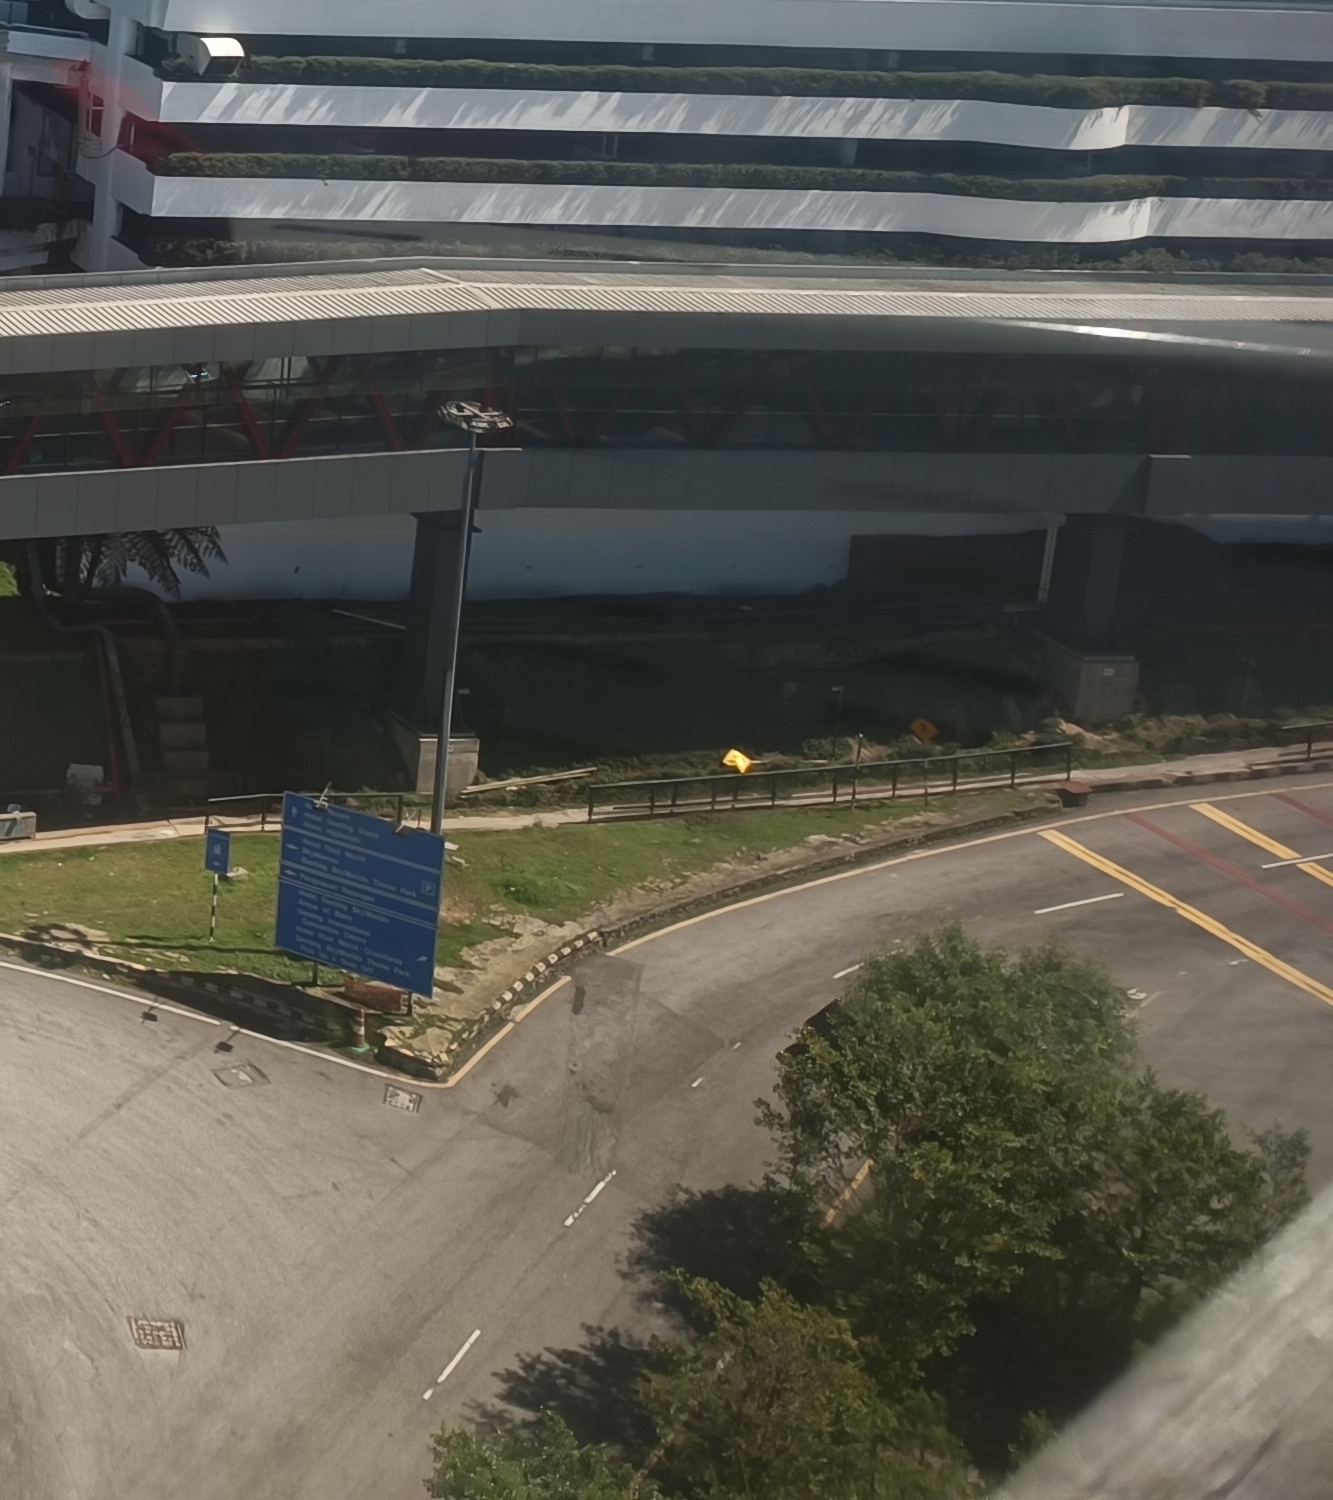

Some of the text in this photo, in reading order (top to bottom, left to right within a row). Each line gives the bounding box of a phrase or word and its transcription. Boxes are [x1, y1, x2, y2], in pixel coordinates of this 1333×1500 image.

[400, 887, 416, 898] Park
[361, 964, 373, 974] Off
[394, 967, 410, 978] Park
